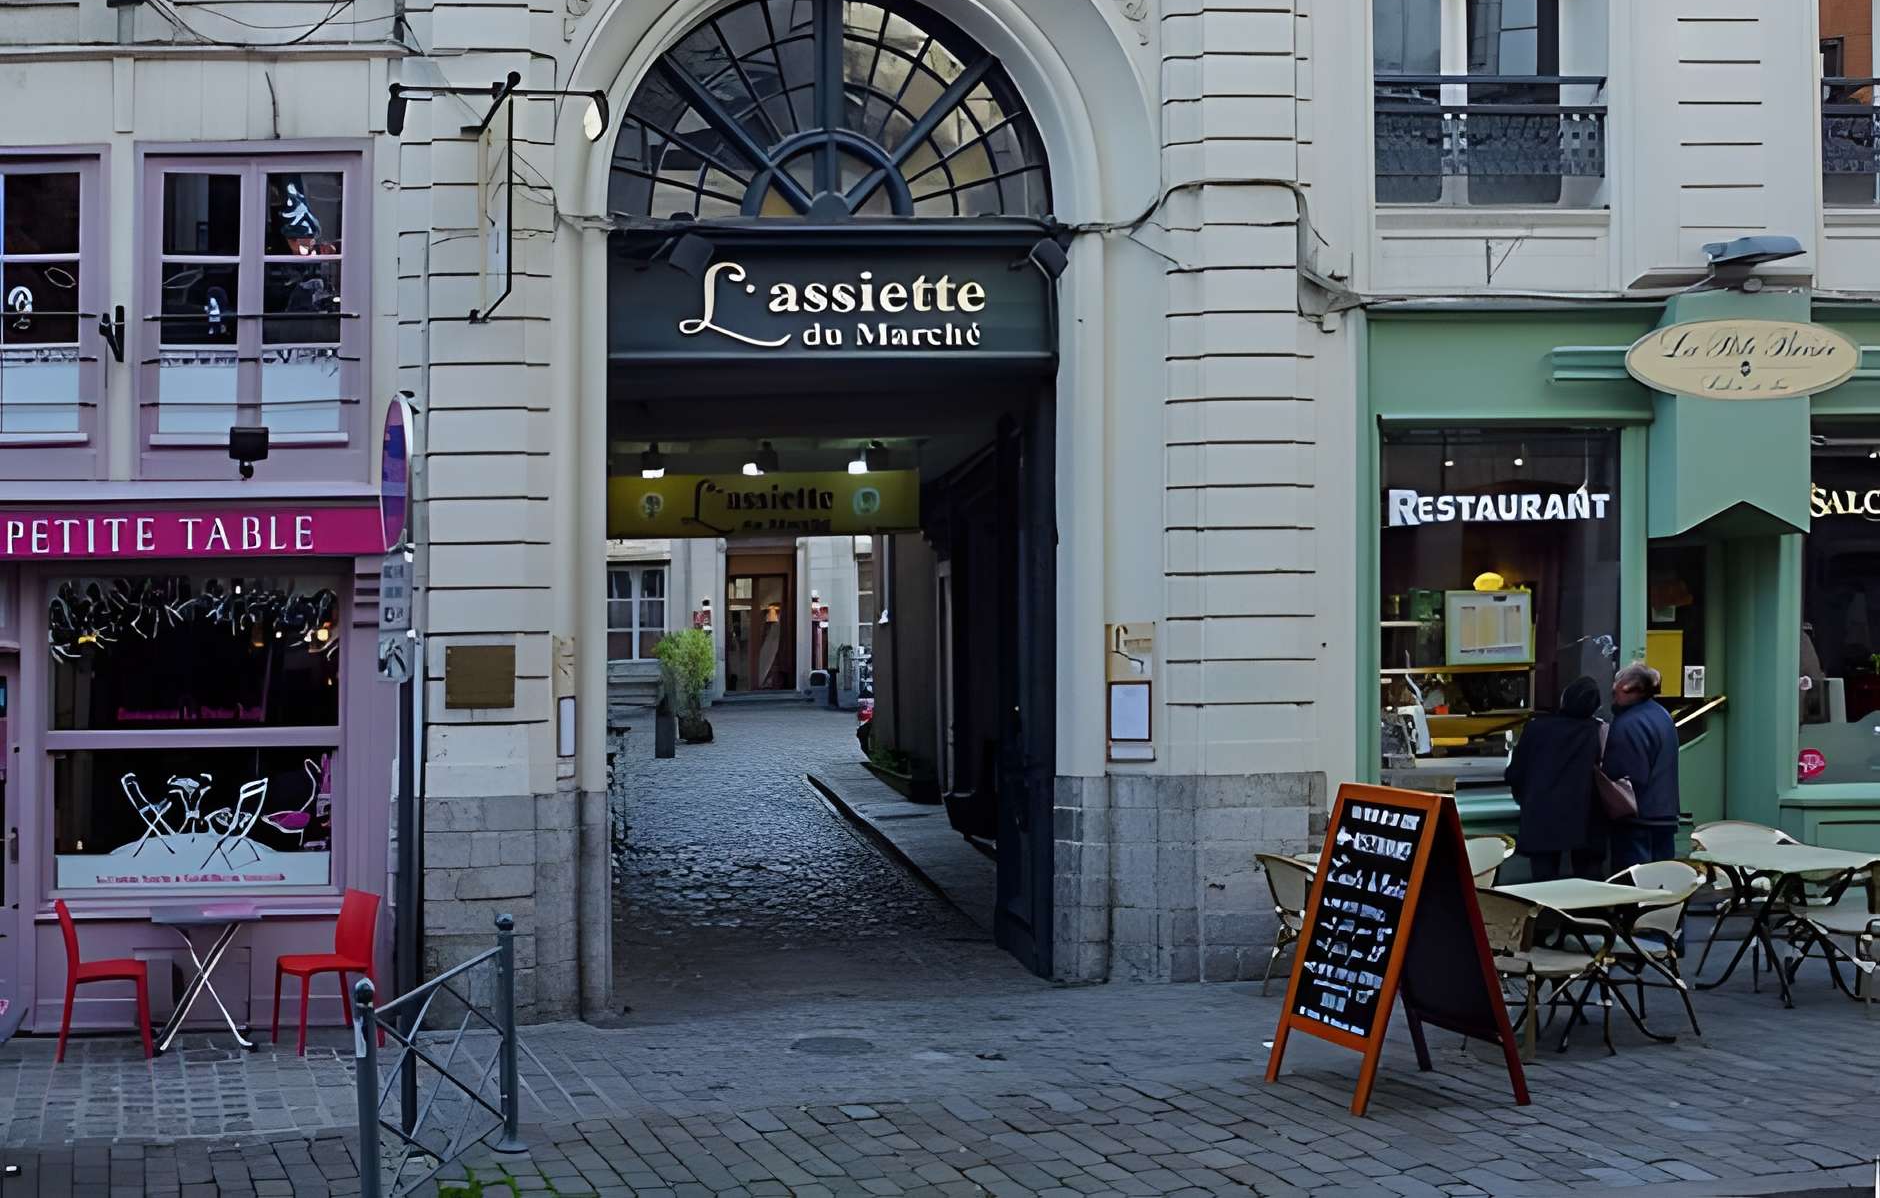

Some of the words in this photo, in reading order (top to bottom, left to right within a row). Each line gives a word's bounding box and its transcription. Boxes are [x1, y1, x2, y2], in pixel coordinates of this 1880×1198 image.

[802, 322, 842, 346] du
[6, 517, 156, 554] PETITE
[178, 516, 314, 551] TABLE
